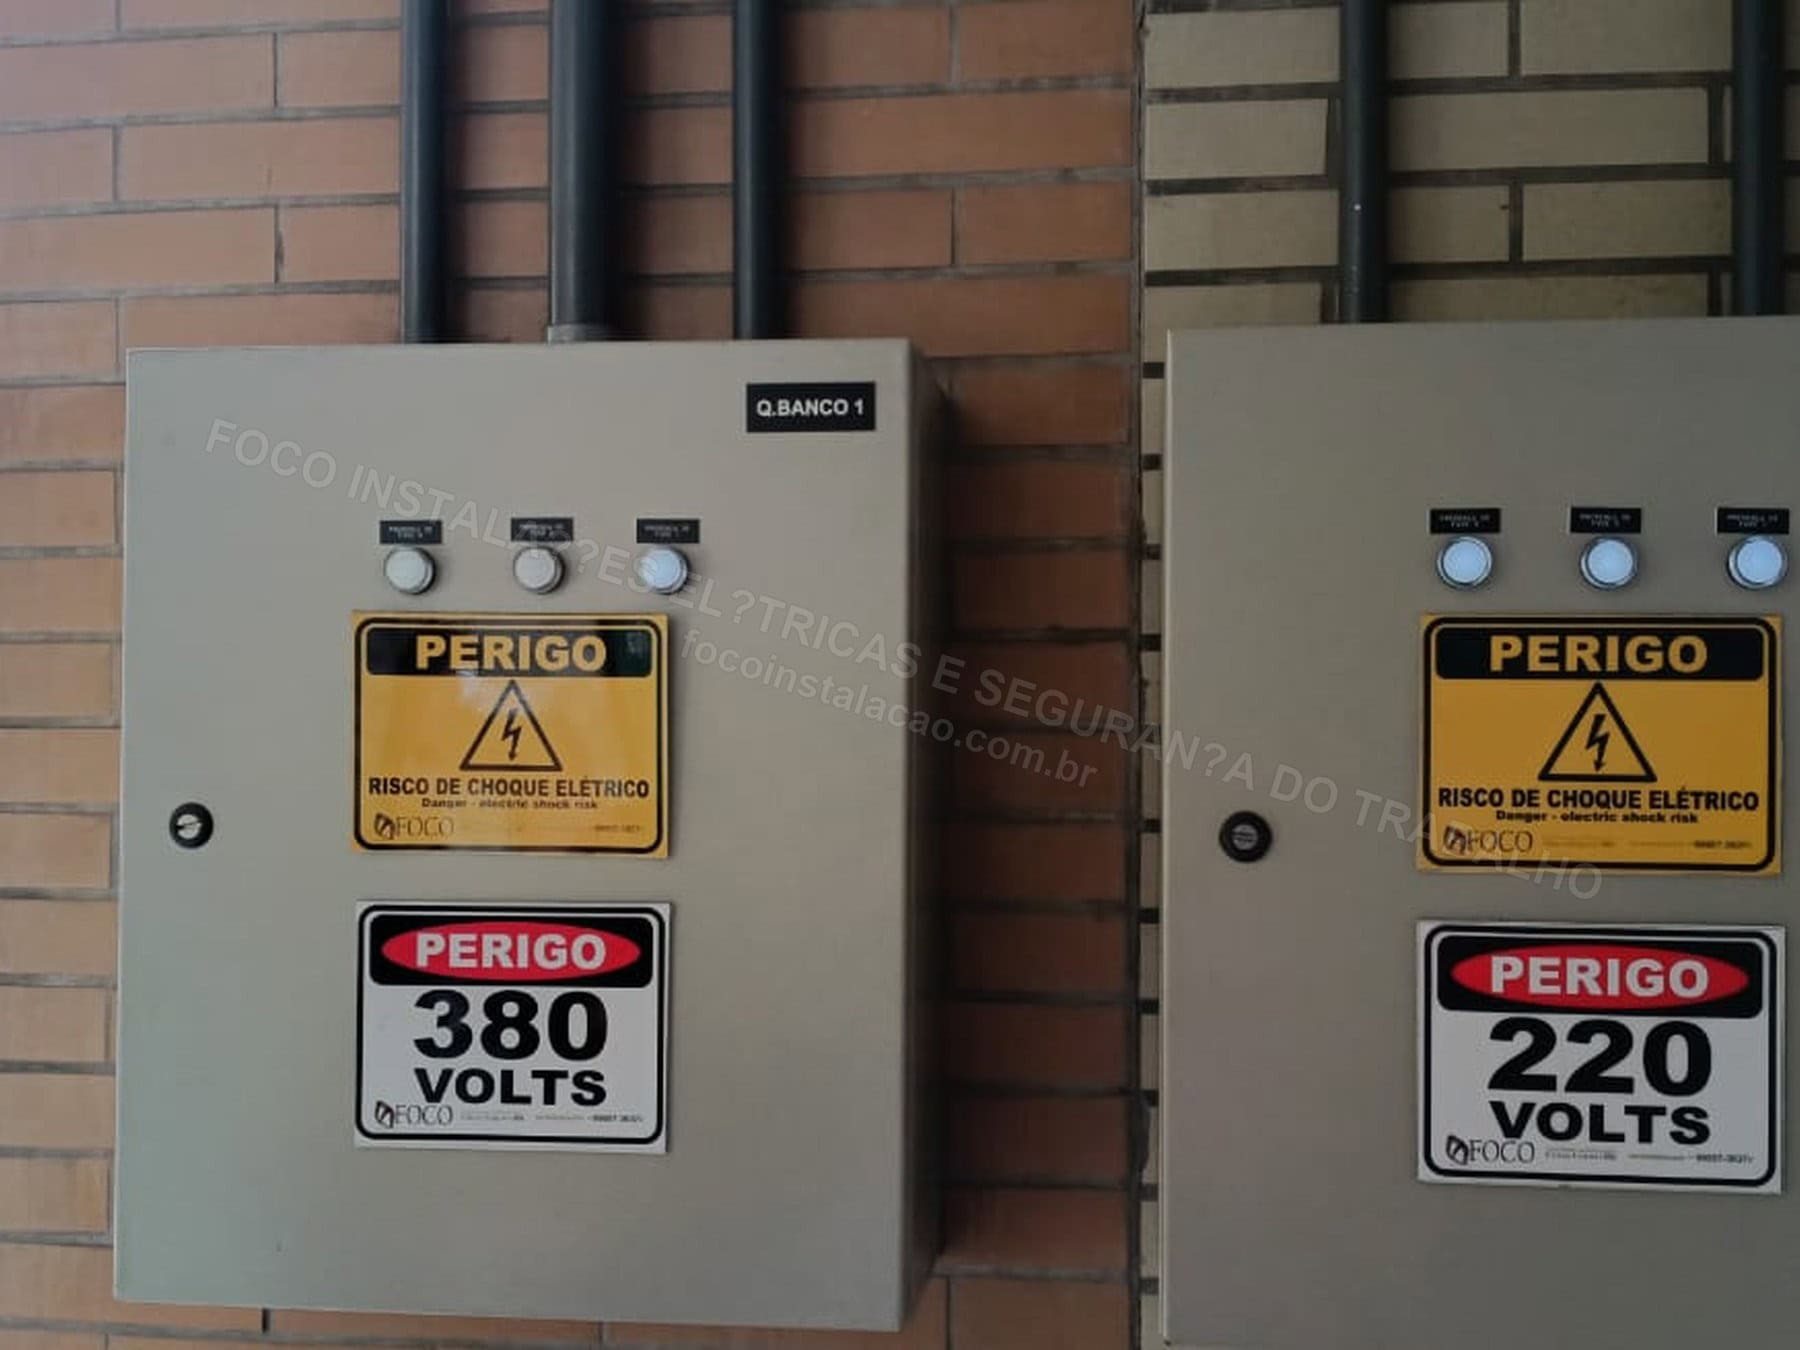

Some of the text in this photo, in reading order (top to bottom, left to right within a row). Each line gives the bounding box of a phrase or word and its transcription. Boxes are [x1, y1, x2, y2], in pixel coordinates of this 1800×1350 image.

[757, 398, 864, 417] Q.BANCO 1
[415, 635, 608, 671] PERIGO
[1490, 634, 1709, 673] PERIGO
[368, 774, 650, 799] RISCO DE CHOQUE ELÉTRICO
[1438, 786, 1760, 812] RISCO DE CHOQUE ELÉTRICO
[421, 797, 467, 811] Danger
[1496, 809, 1548, 823] Danger
[1561, 810, 1618, 823] electric
[1622, 811, 1667, 824] shock
[1670, 811, 1698, 824] risk
[395, 815, 454, 838] FOCO
[1467, 829, 1533, 853] FOCO
[415, 932, 607, 970] PERIGO
[1490, 955, 1709, 998] PERIGO
[413, 988, 608, 1061] 380
[1487, 1016, 1712, 1097] 220
[414, 1067, 607, 1106] VOLTS
[395, 1103, 453, 1127] FOCO
[1490, 1100, 1711, 1145] VOLTS
[1469, 1139, 1535, 1164] FOCO
